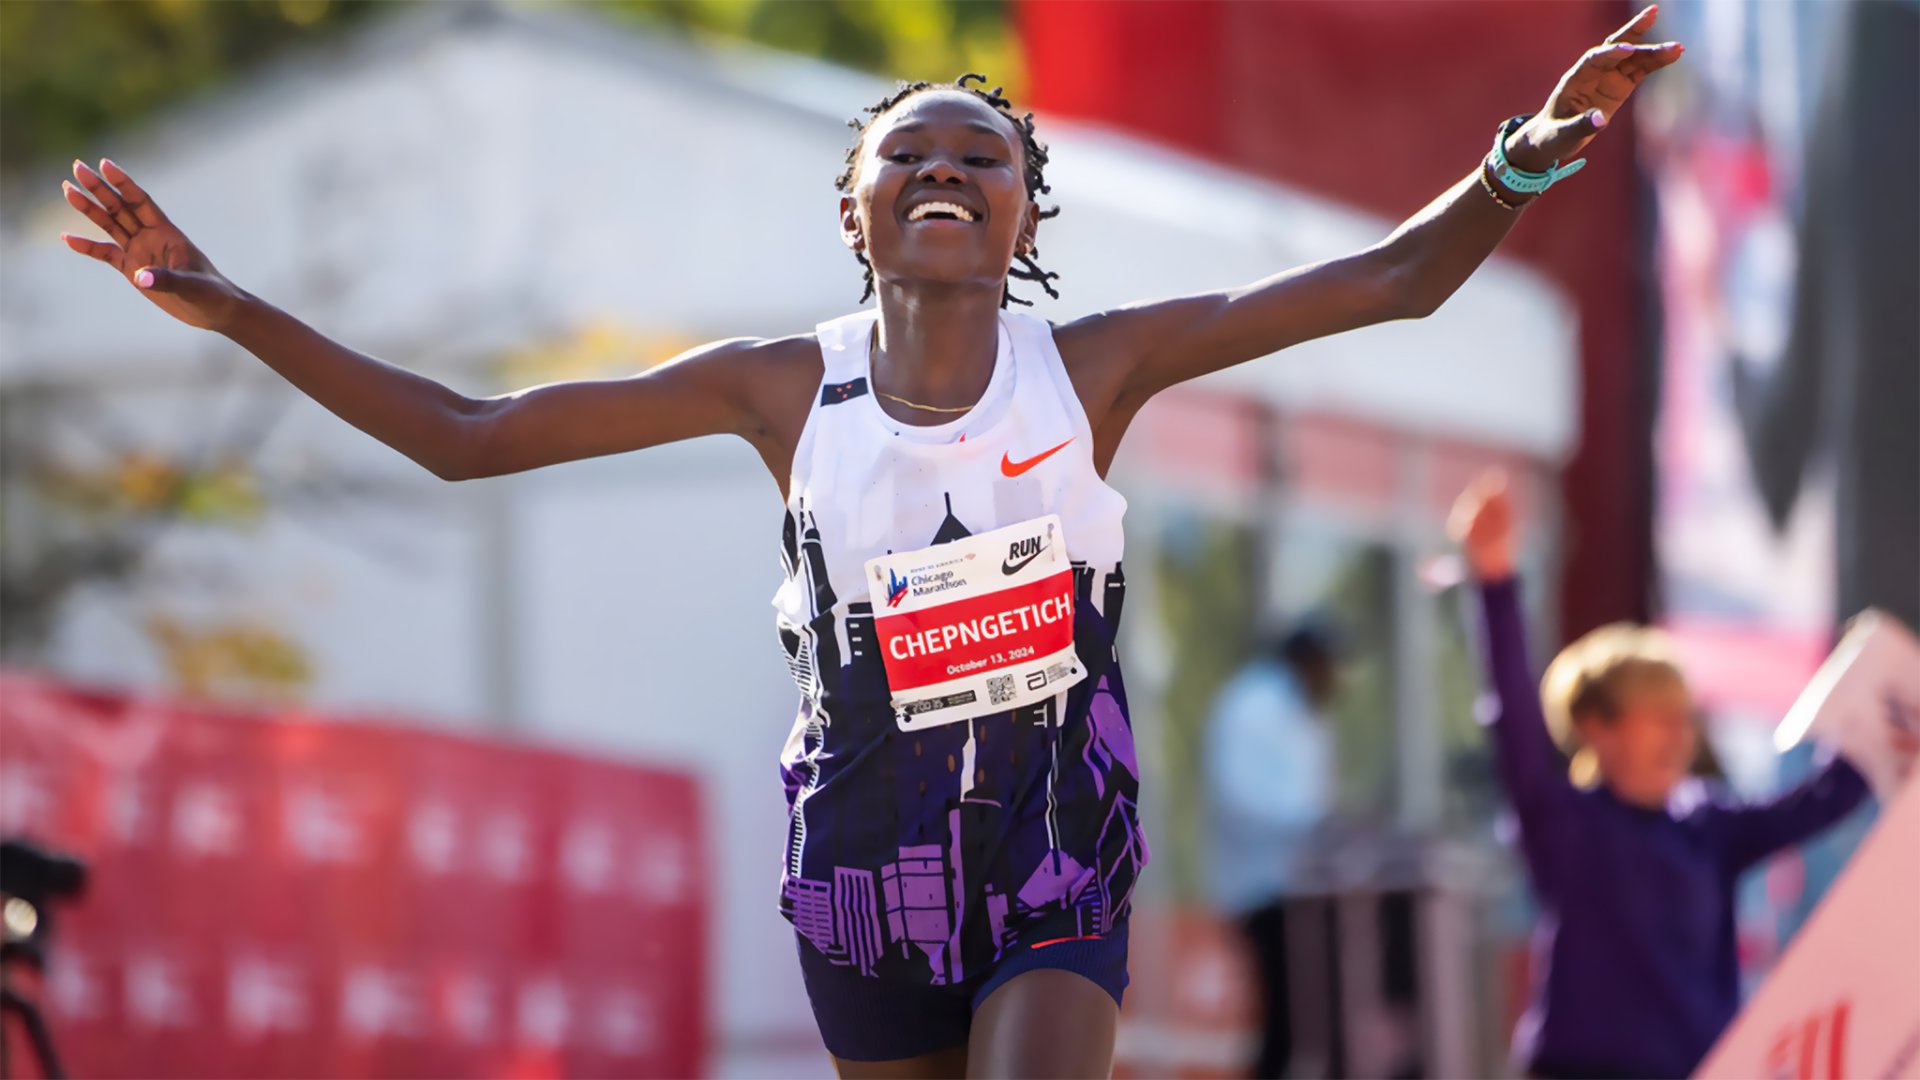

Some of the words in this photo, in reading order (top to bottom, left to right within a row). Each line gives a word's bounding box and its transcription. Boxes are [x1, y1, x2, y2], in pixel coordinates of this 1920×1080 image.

[1009, 535, 1041, 560] RUN
[911, 570, 954, 586] Chicago
[913, 578, 967, 597] Marathon
[889, 592, 1071, 660] CHEPNGETICH
[946, 658, 987, 675] October
[990, 652, 1007, 664] 13,
[1008, 645, 1034, 660] 2024
